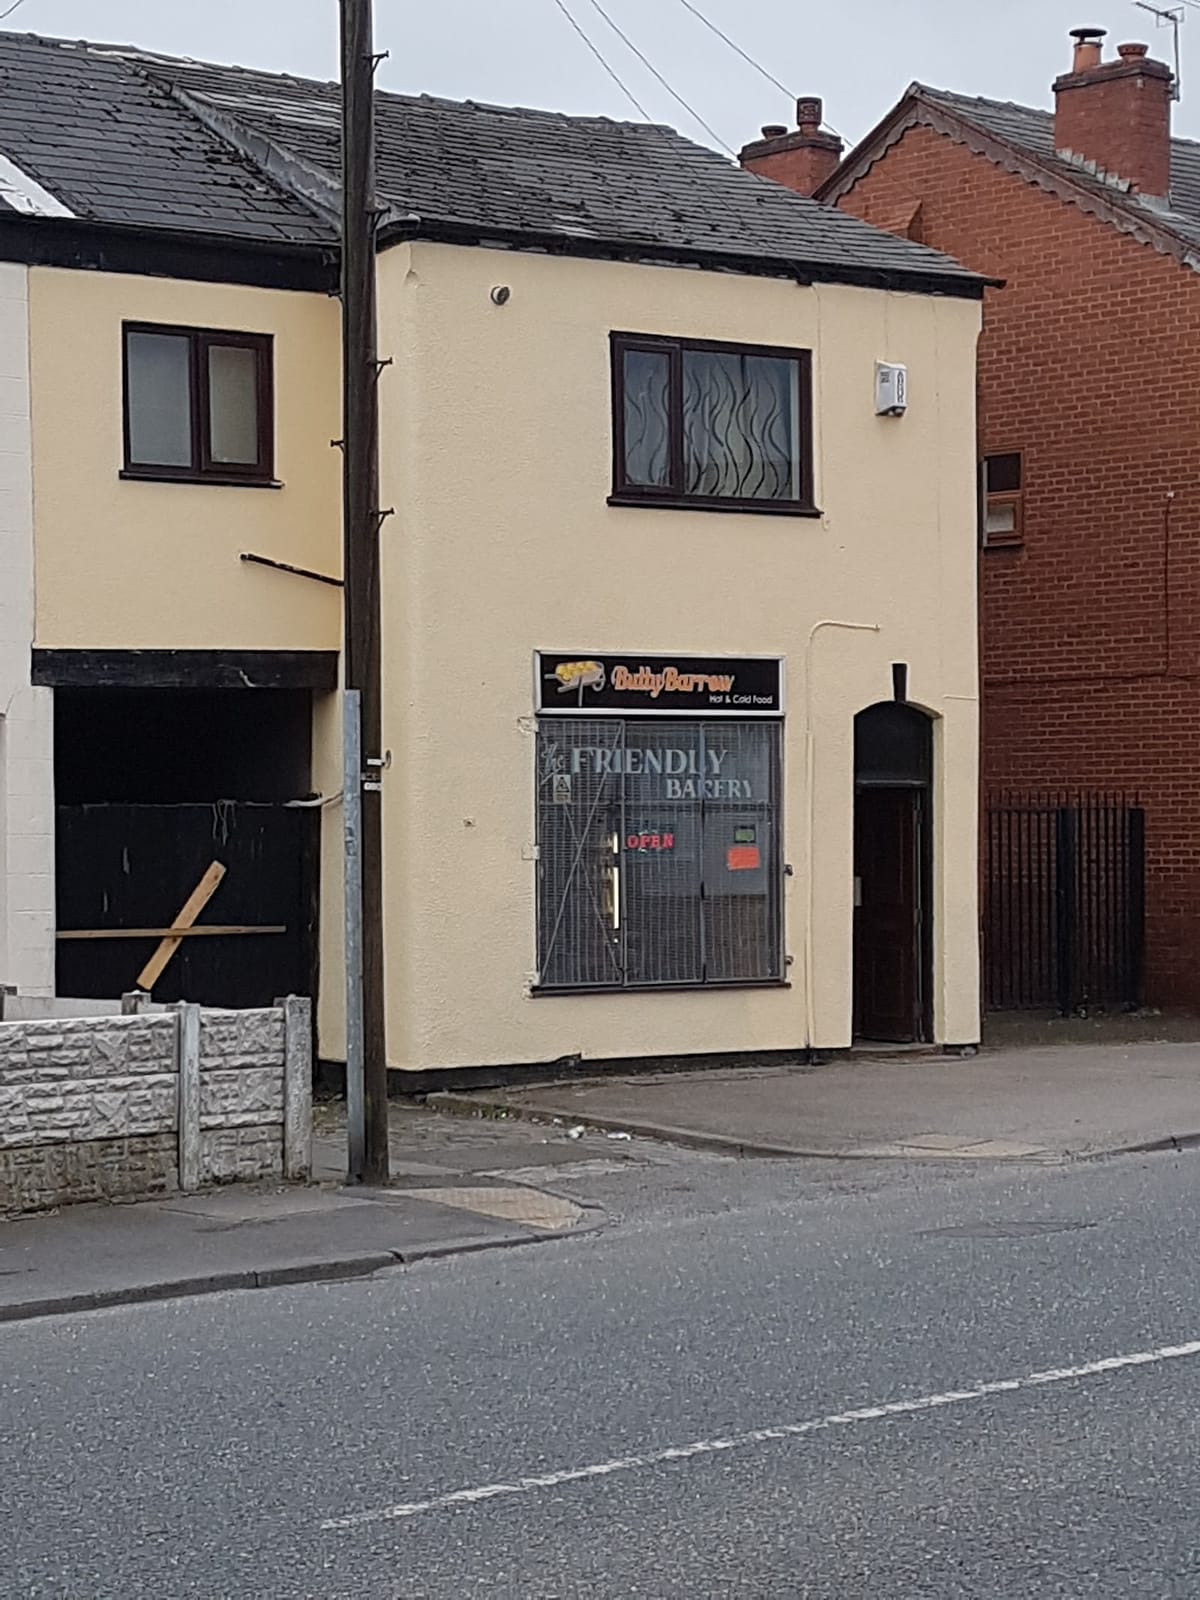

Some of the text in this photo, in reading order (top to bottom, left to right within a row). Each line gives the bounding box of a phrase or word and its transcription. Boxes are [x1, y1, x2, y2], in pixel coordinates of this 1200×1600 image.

[709, 694, 773, 704] Hot & Cold Food
[572, 747, 729, 775] FRIENDLY
[626, 832, 675, 850] OPEN
